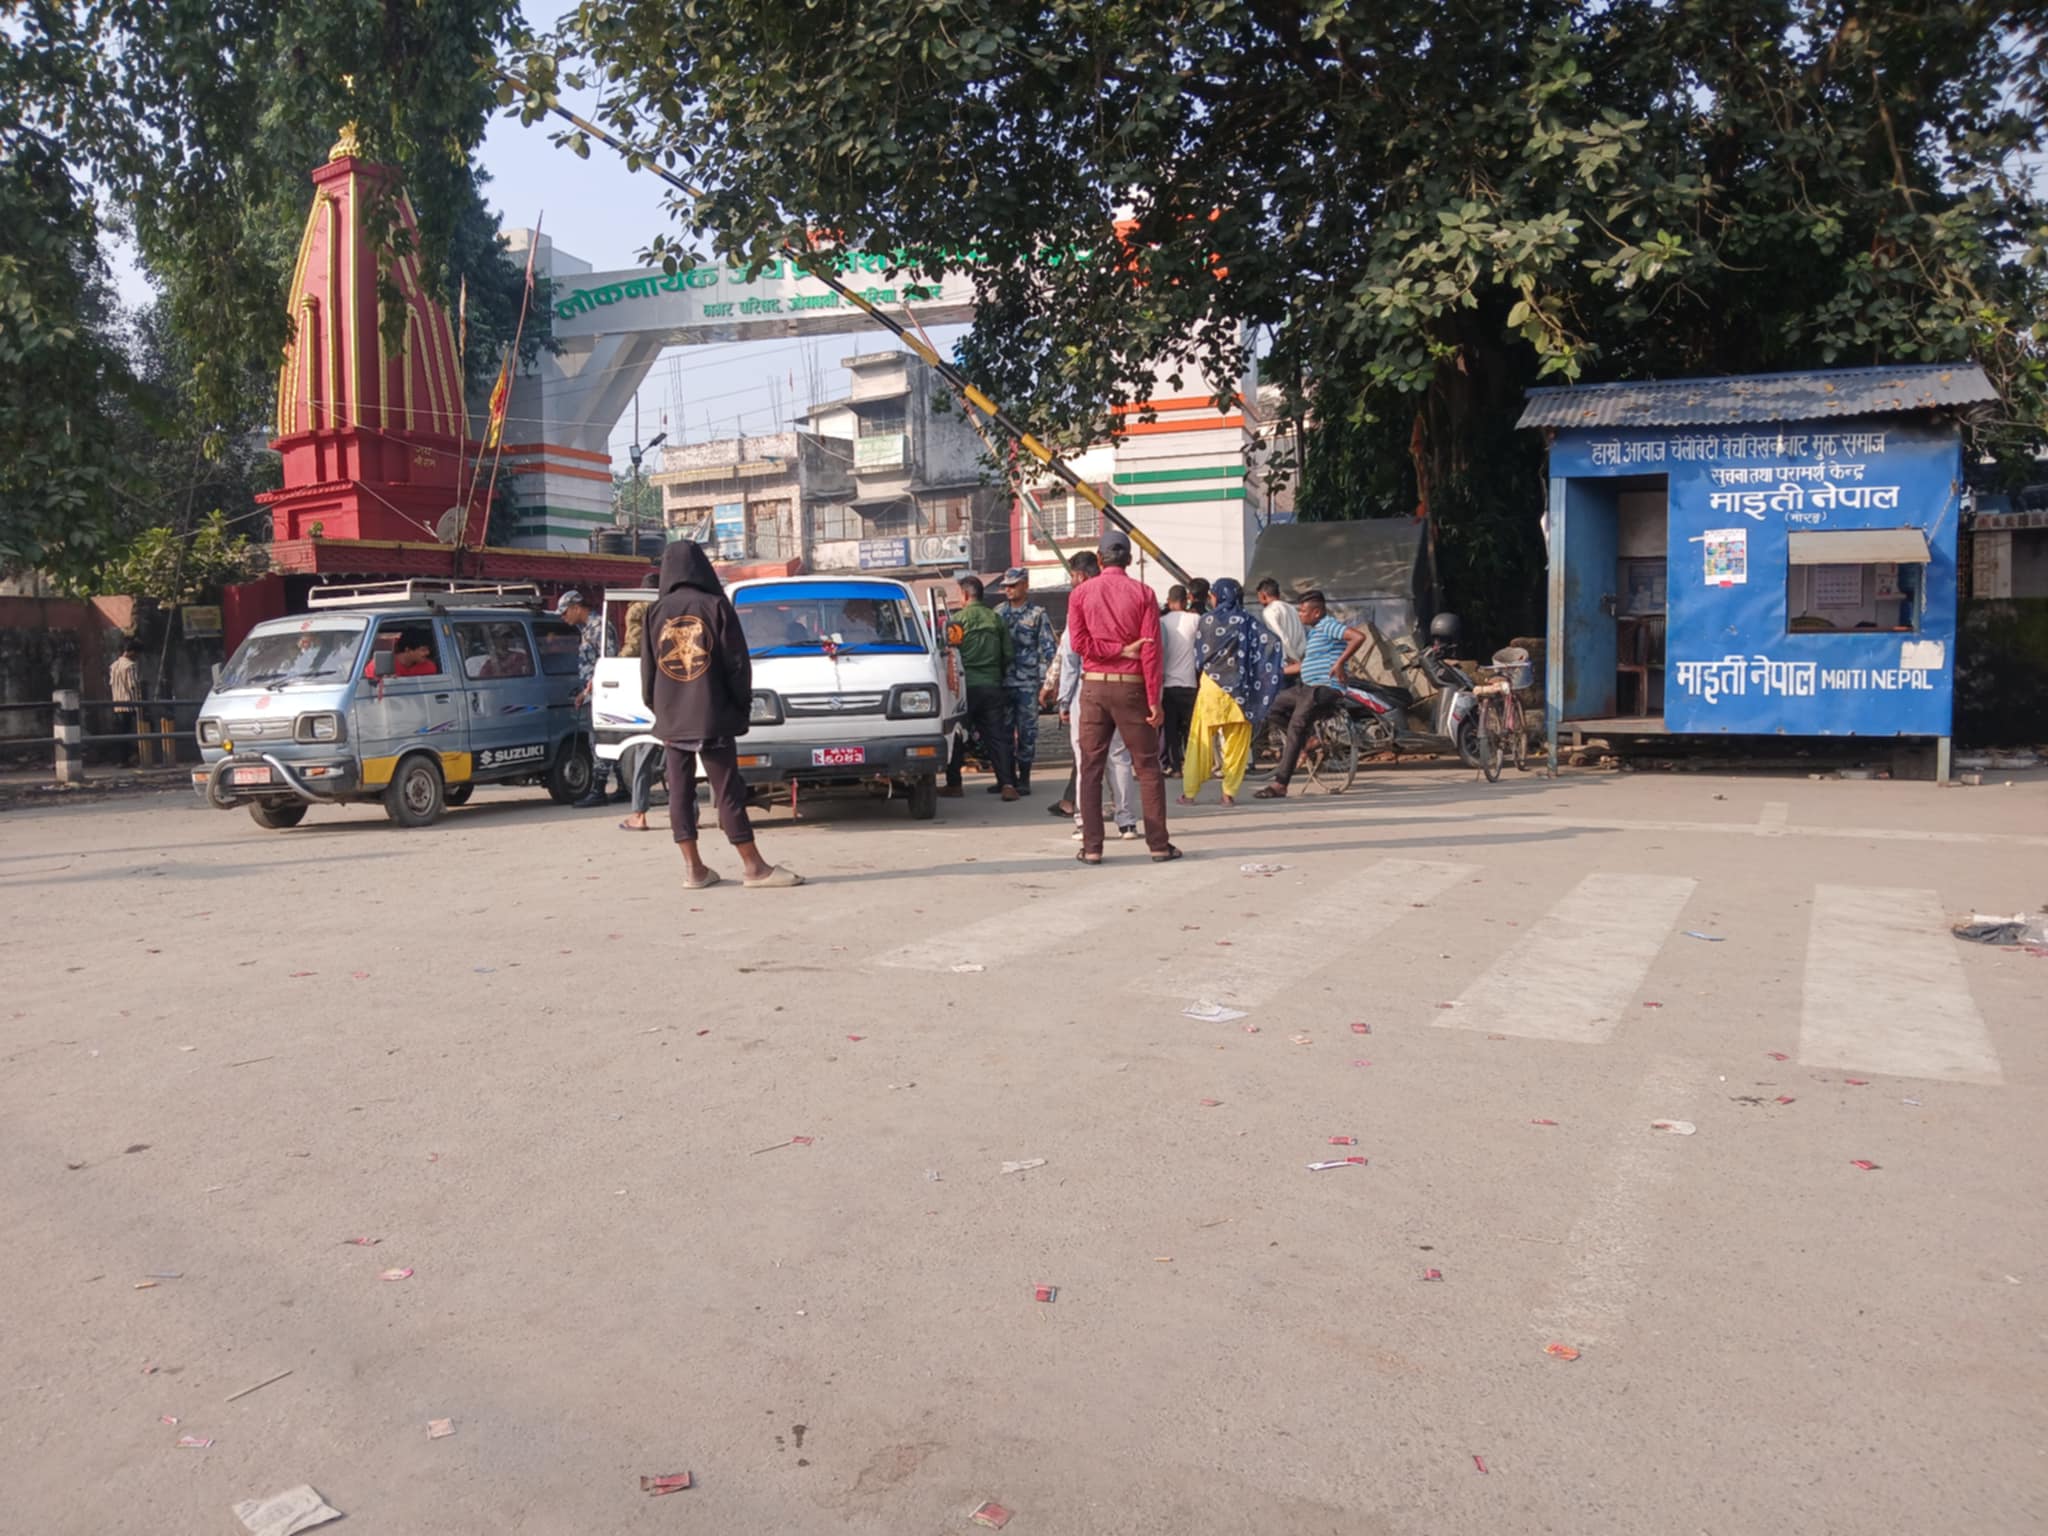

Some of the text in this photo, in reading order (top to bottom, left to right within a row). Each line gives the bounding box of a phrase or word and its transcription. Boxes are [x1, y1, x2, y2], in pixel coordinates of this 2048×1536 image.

[554, 267, 718, 319] लोकनायक
[1591, 437, 1621, 465] हाम्रो
[1622, 441, 1666, 463] आवाज
[1670, 434, 1720, 461] चेलीबेटी
[1841, 432, 1885, 458] समाज
[1776, 462, 1826, 482] परामर्श
[1828, 460, 1866, 480] केन्द्र
[1709, 481, 1900, 521] माइती नेपाल
[1676, 655, 1817, 704] माइती नेपाल
[1821, 669, 1933, 690] MAITI NEPAL
[495, 745, 545, 762] SUZUKI
